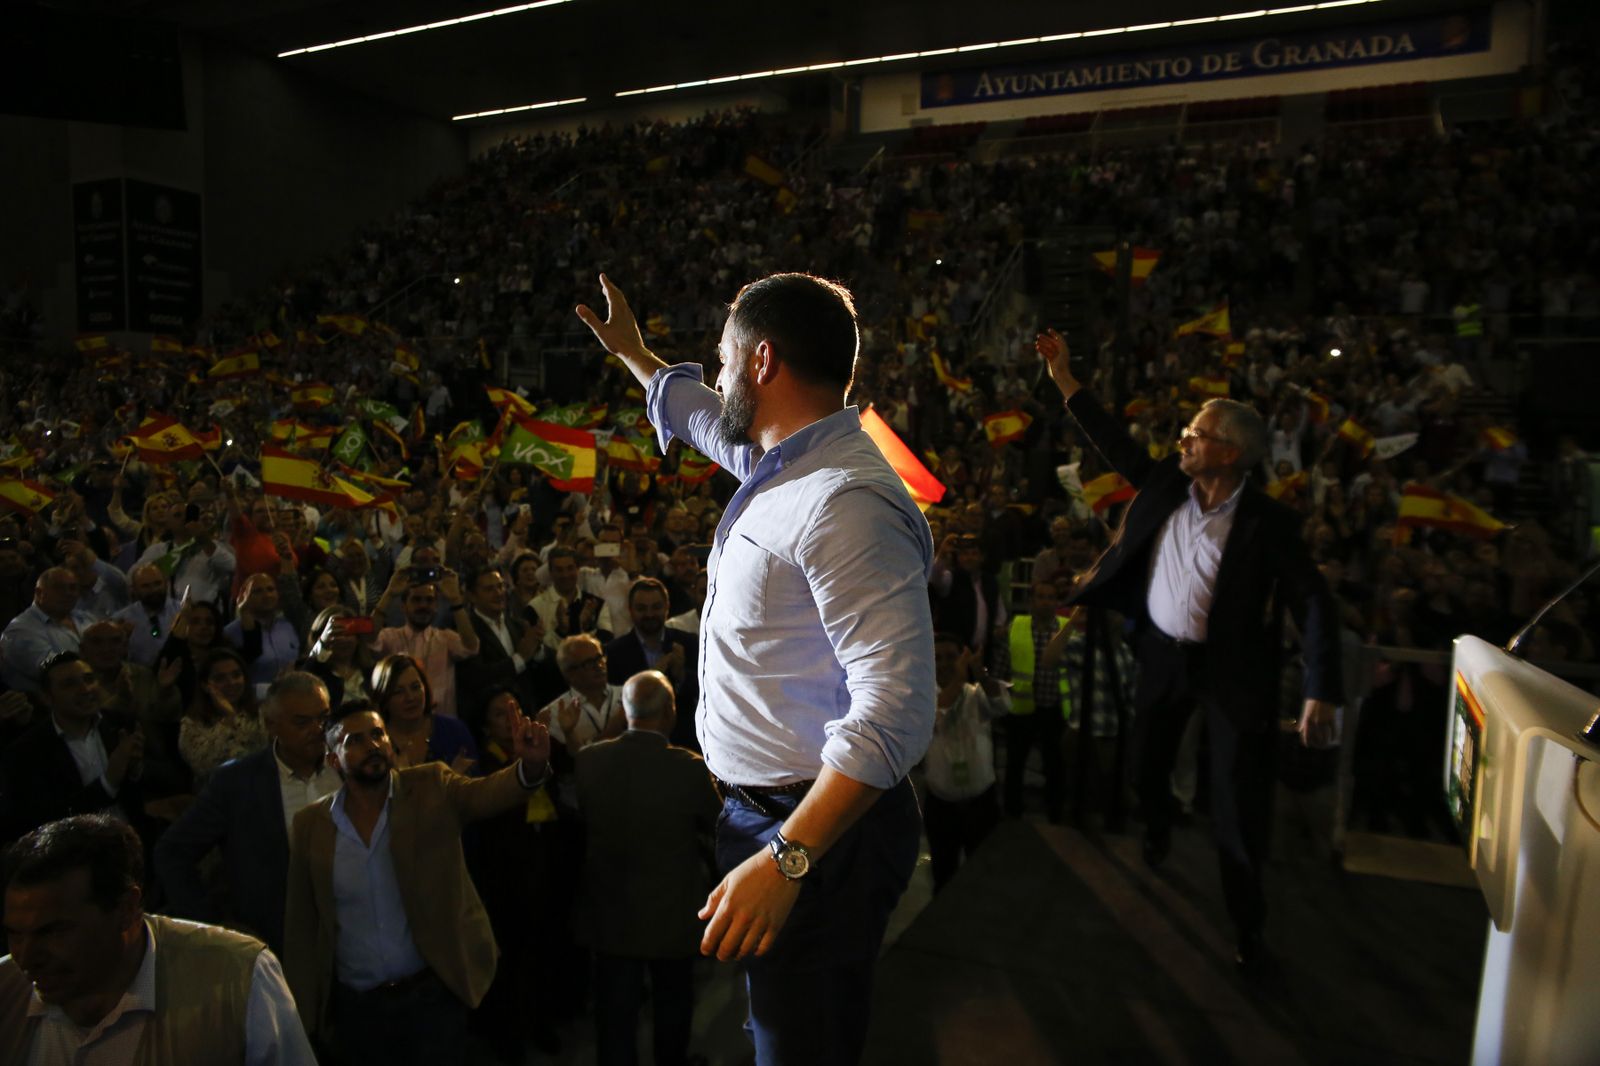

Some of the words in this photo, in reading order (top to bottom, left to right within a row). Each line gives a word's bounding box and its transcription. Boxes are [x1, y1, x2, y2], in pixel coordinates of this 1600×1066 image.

[973, 57, 1192, 97] AYUNTAMIENTO
[1200, 51, 1242, 75] DE
[1252, 32, 1416, 68] GRANADA
[512, 441, 569, 473] VOX
